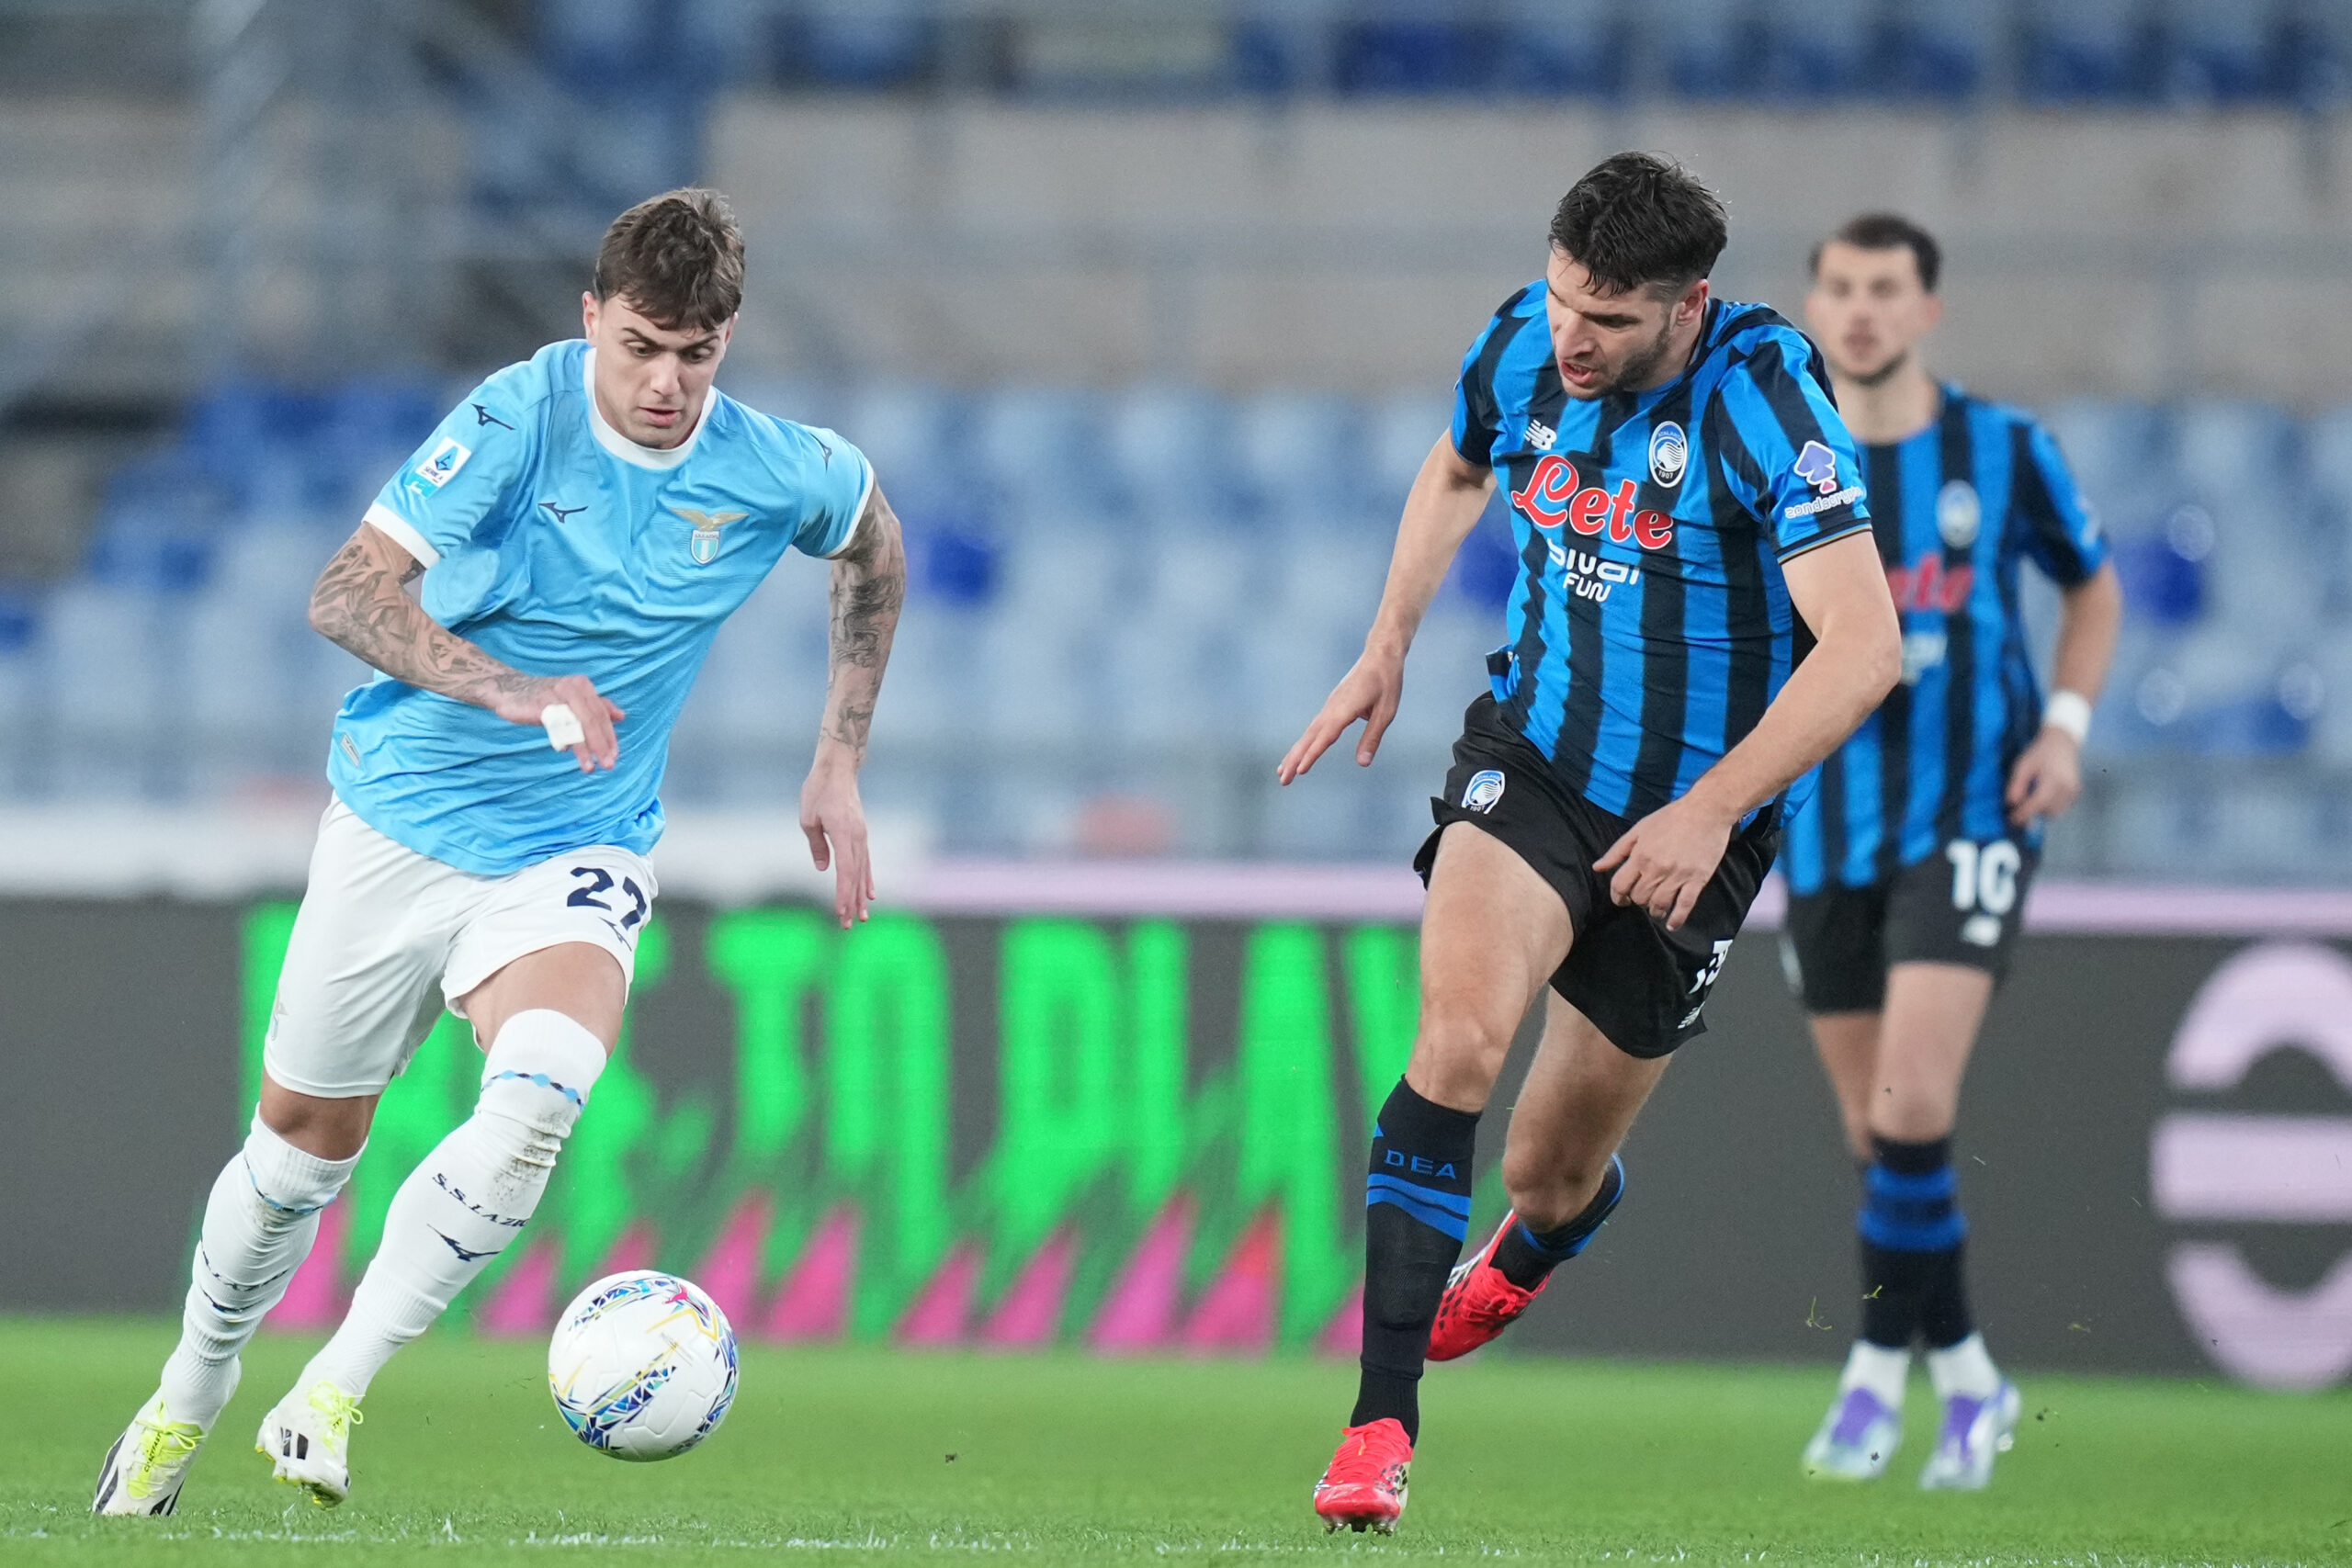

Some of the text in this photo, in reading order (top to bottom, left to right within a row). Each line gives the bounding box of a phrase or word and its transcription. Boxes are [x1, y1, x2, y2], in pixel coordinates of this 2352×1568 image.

[1658, 469, 1674, 479] 1907
[1511, 455, 1673, 550] Lete
[1563, 571, 1611, 603] FUN
[567, 866, 647, 931] 27
[1947, 840, 2019, 913] 10
[1384, 1148, 1456, 1179] DEA
